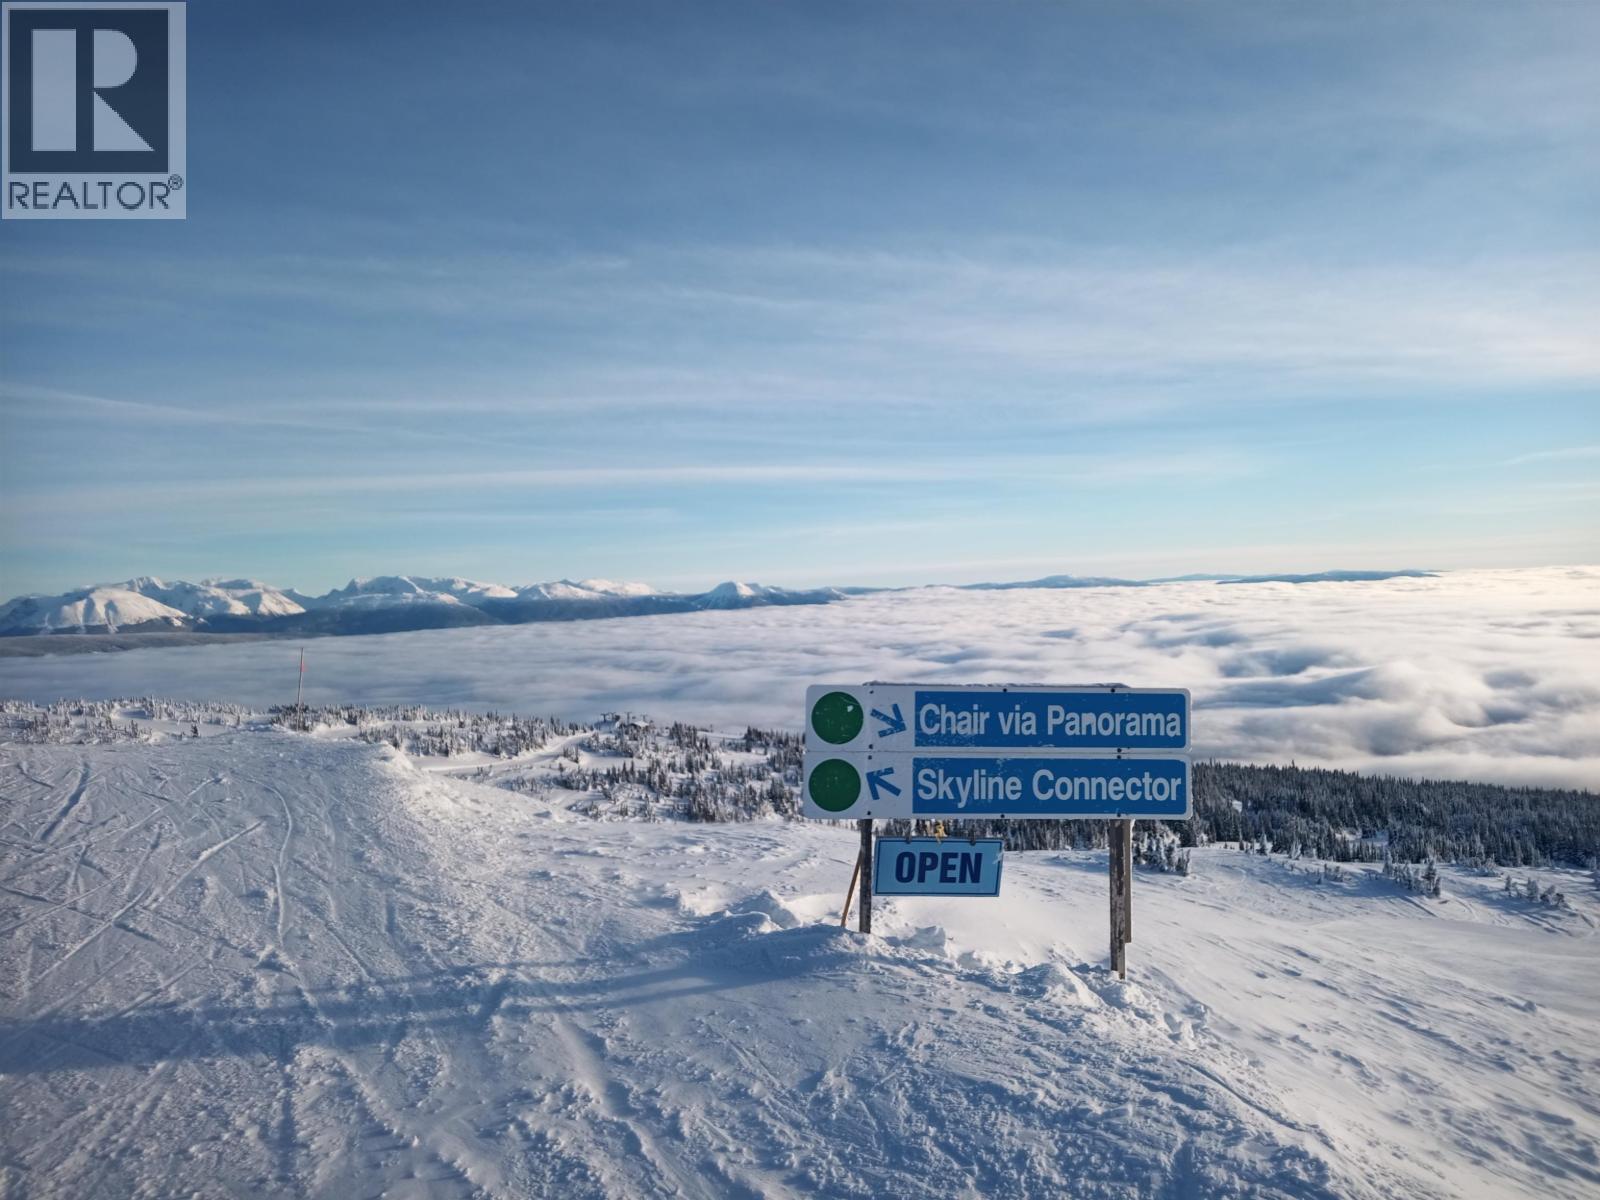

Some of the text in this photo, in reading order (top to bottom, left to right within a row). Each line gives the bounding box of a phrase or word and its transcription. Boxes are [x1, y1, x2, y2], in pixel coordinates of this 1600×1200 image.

[919, 703, 1182, 737] Chair via Panorama
[917, 769, 1182, 808] Skyline Connector
[895, 851, 983, 884] OPEN
